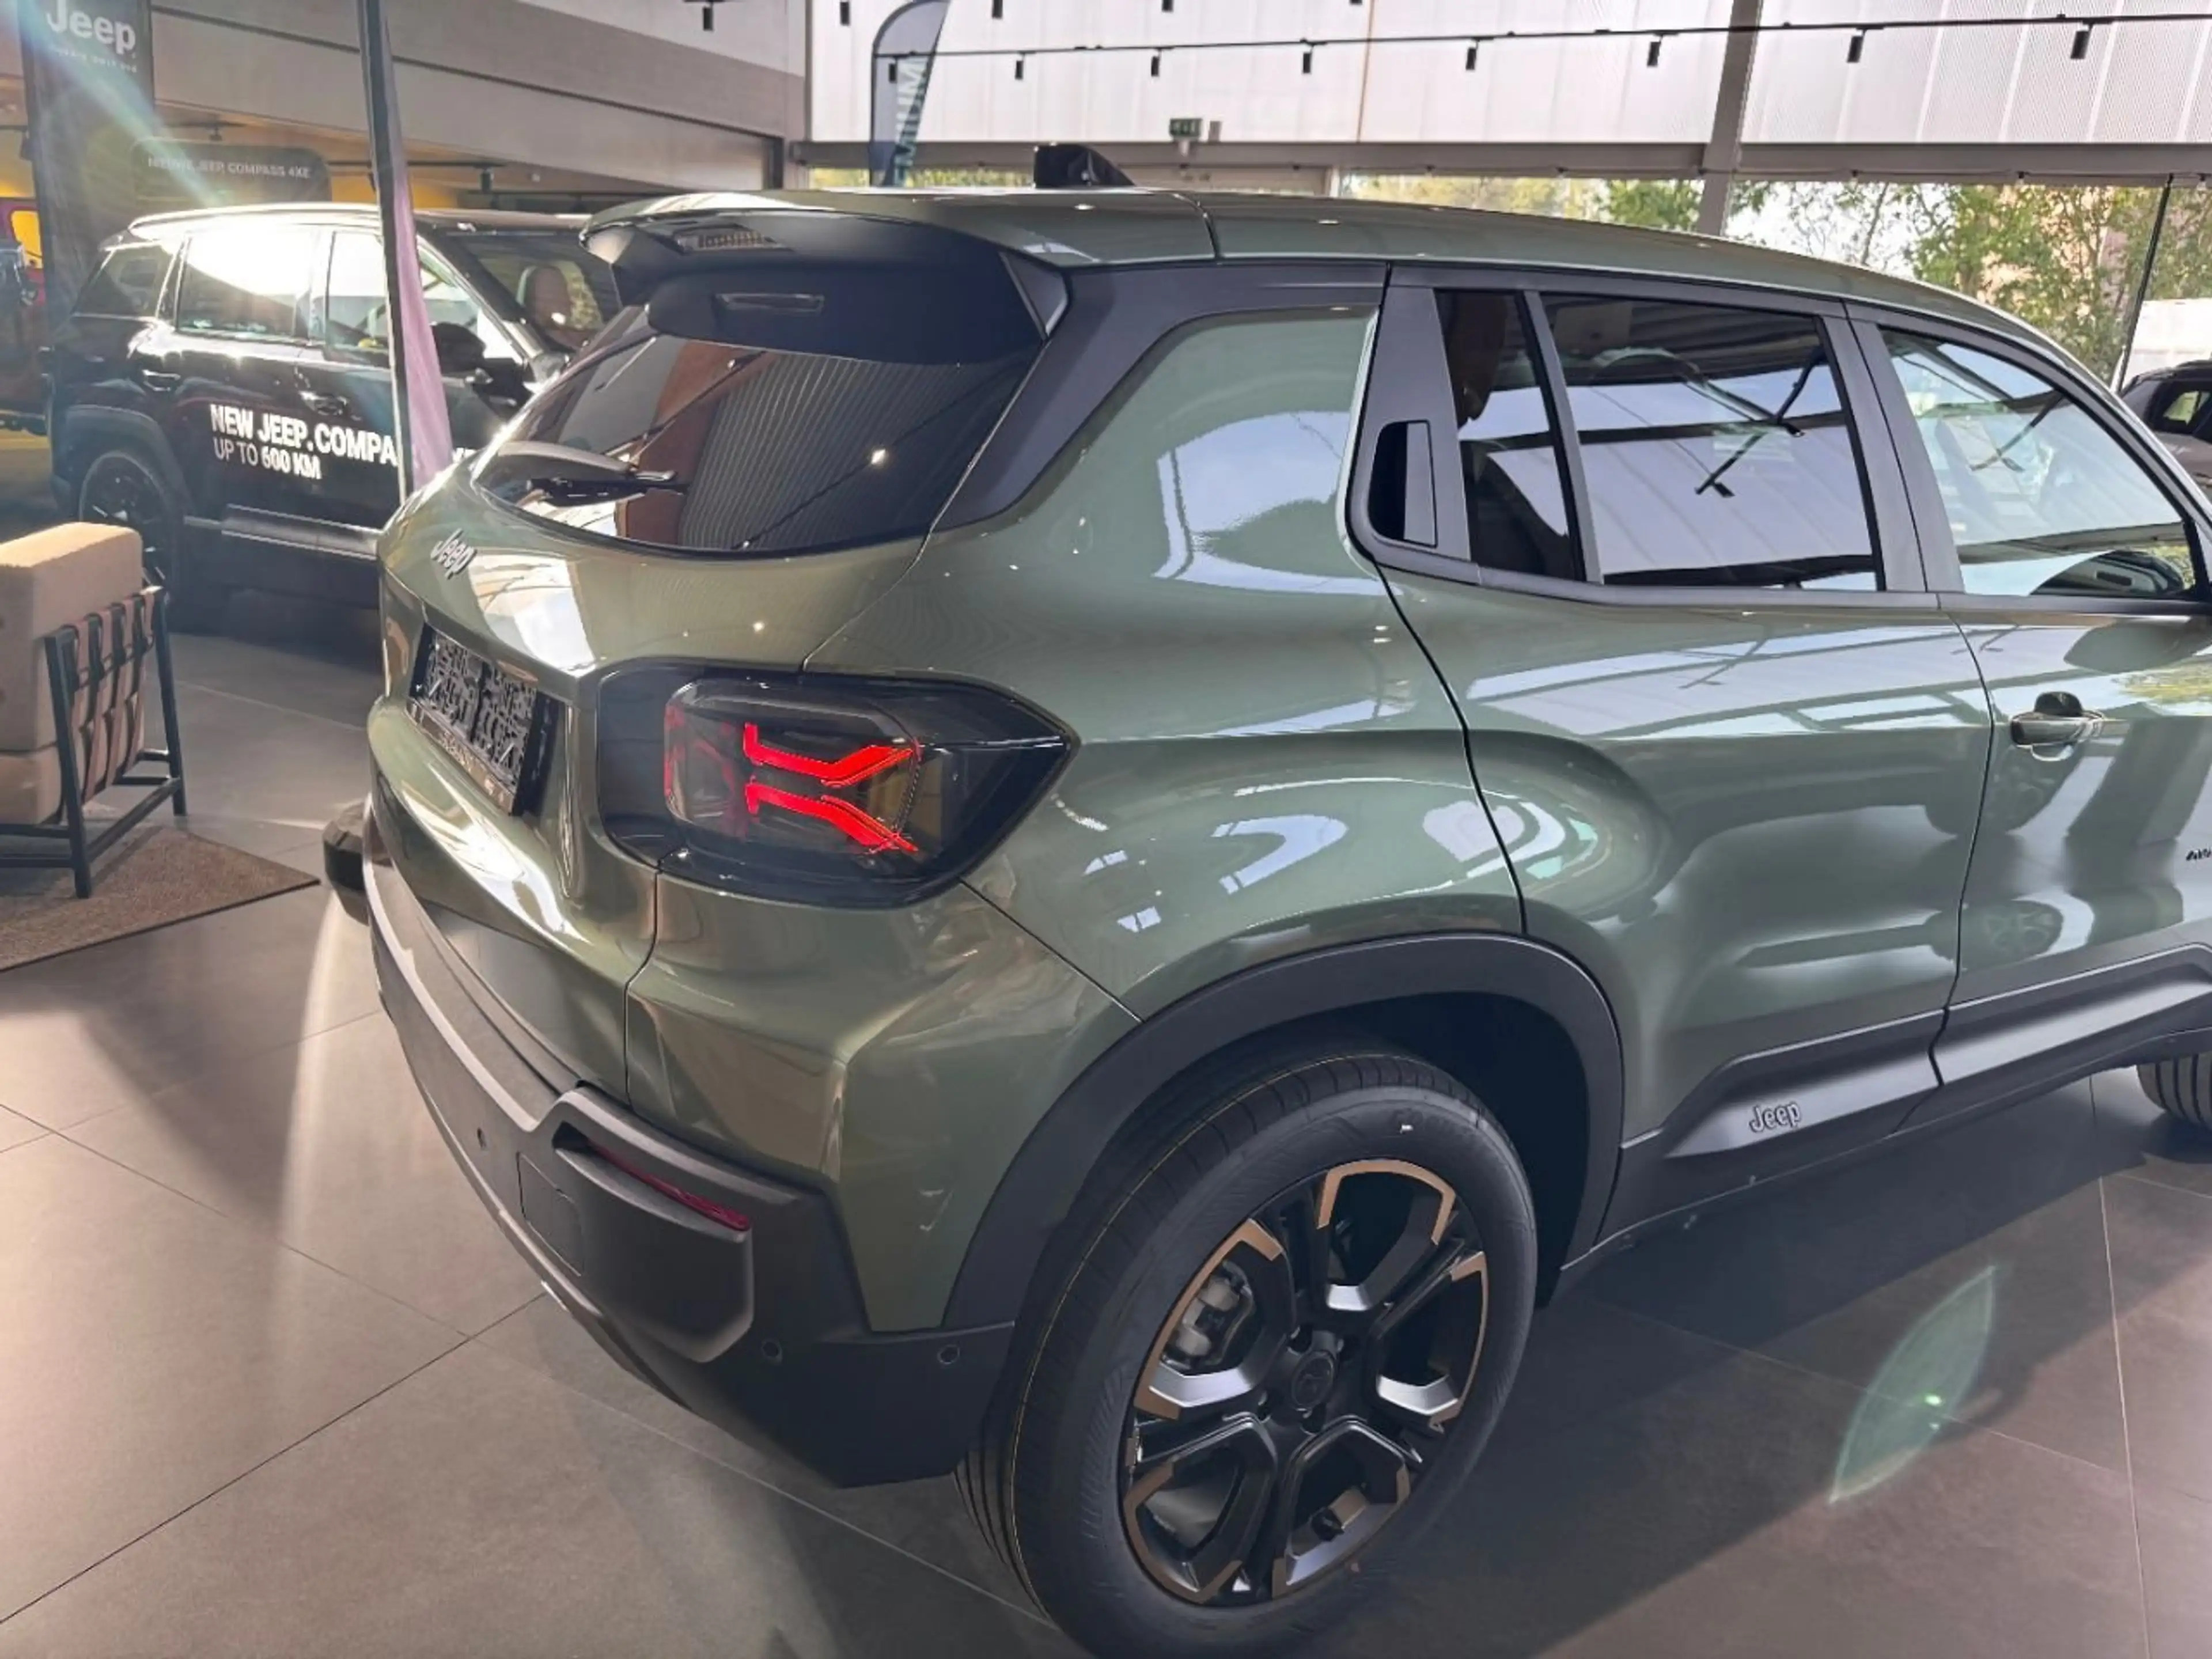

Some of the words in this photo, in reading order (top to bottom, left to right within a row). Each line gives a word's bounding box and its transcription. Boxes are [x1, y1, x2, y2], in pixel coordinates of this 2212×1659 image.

[46, 0, 136, 55] Jeep
[210, 404, 253, 440] NEW
[213, 437, 234, 461] UP
[236, 441, 258, 466] TO
[262, 446, 291, 474] 600
[292, 452, 322, 479] KM
[430, 528, 475, 578] Jeep
[1749, 1103, 1801, 1132] Jeep
